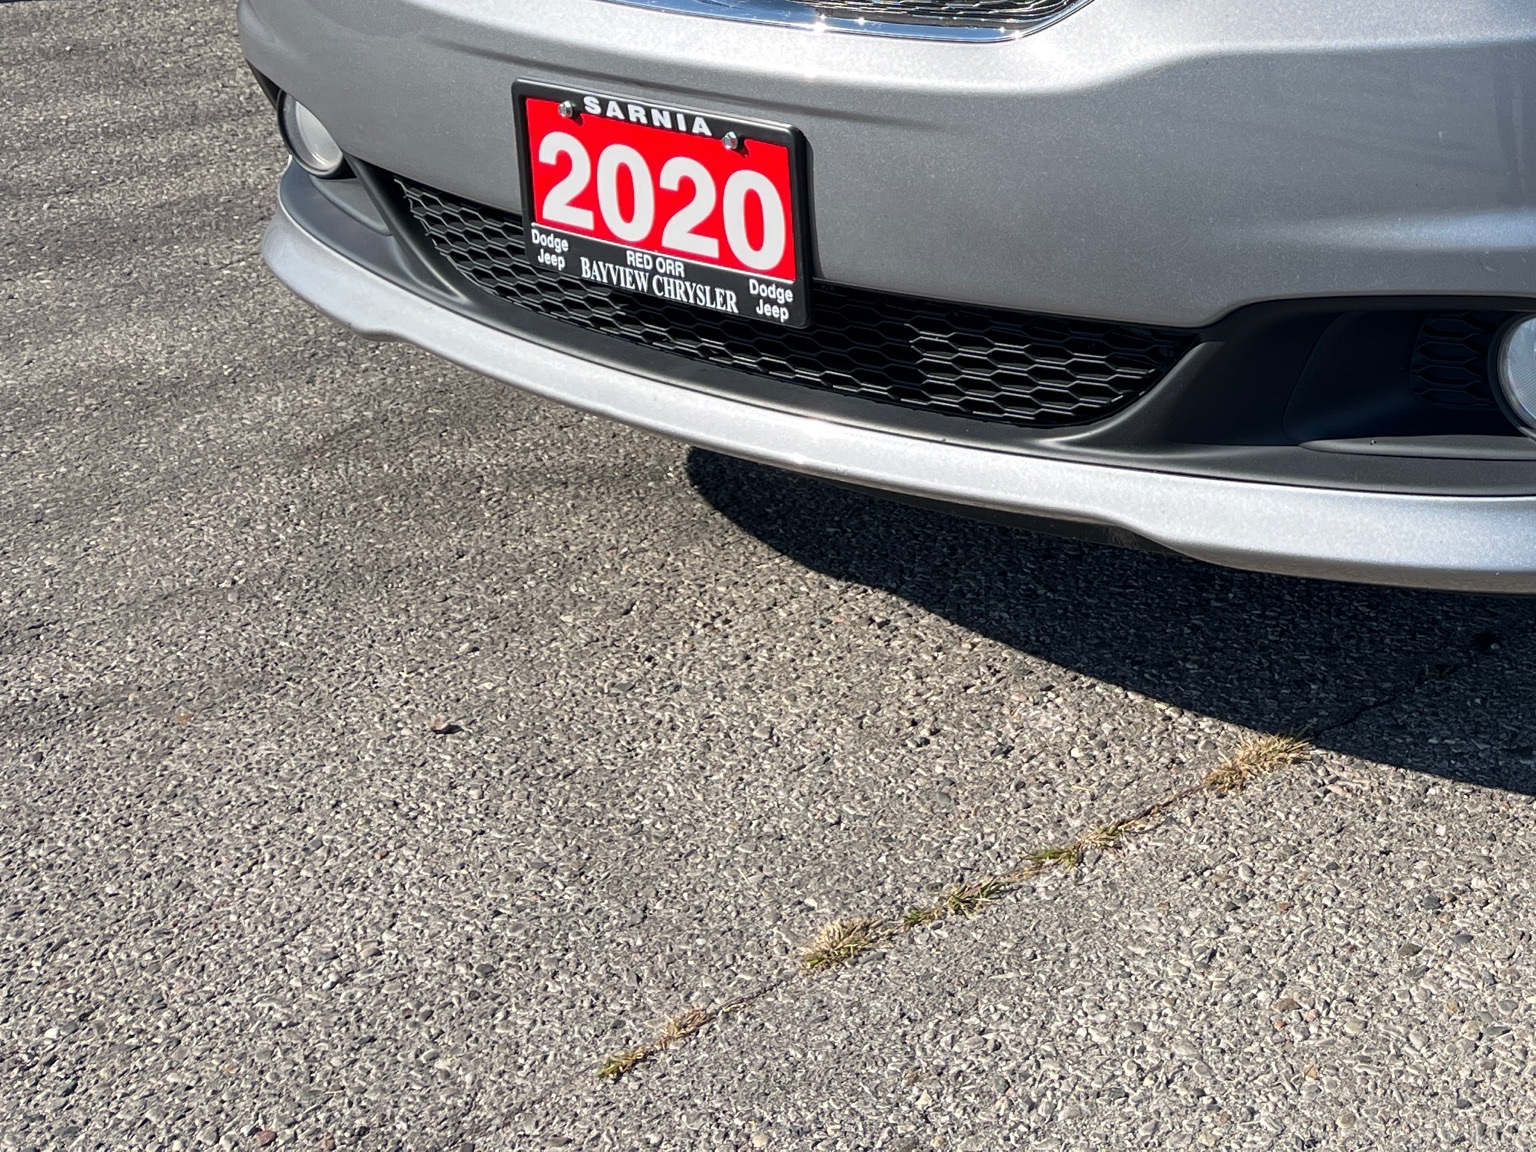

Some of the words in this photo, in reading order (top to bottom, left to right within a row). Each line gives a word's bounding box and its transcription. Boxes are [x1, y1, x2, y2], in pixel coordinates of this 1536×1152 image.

[583, 95, 712, 136] SARNIA
[538, 131, 786, 271] 2020
[531, 228, 569, 253] Dodge
[537, 248, 566, 271] Jeep
[626, 250, 653, 269] RED
[656, 257, 685, 278] ORR
[580, 257, 649, 293] BAYVIEW
[652, 275, 739, 314] CHRYSLER
[749, 278, 794, 304] Dodge
[756, 299, 789, 323] Jeep
